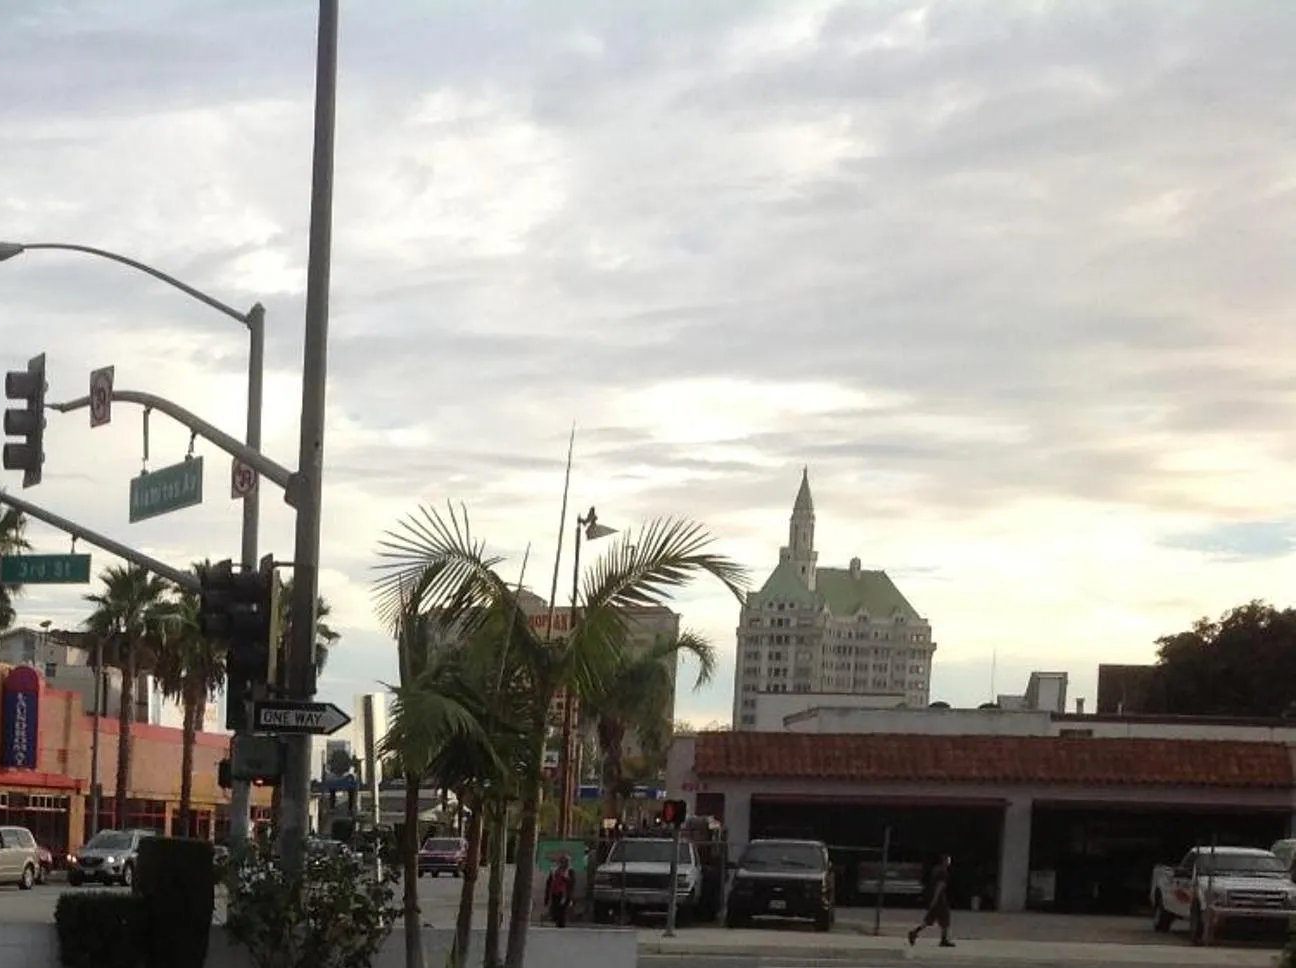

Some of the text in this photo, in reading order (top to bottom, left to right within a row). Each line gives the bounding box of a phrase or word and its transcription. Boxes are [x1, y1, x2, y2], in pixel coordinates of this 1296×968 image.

[17, 560, 72, 579] 3rd St
[263, 710, 322, 726] ONE WAY
